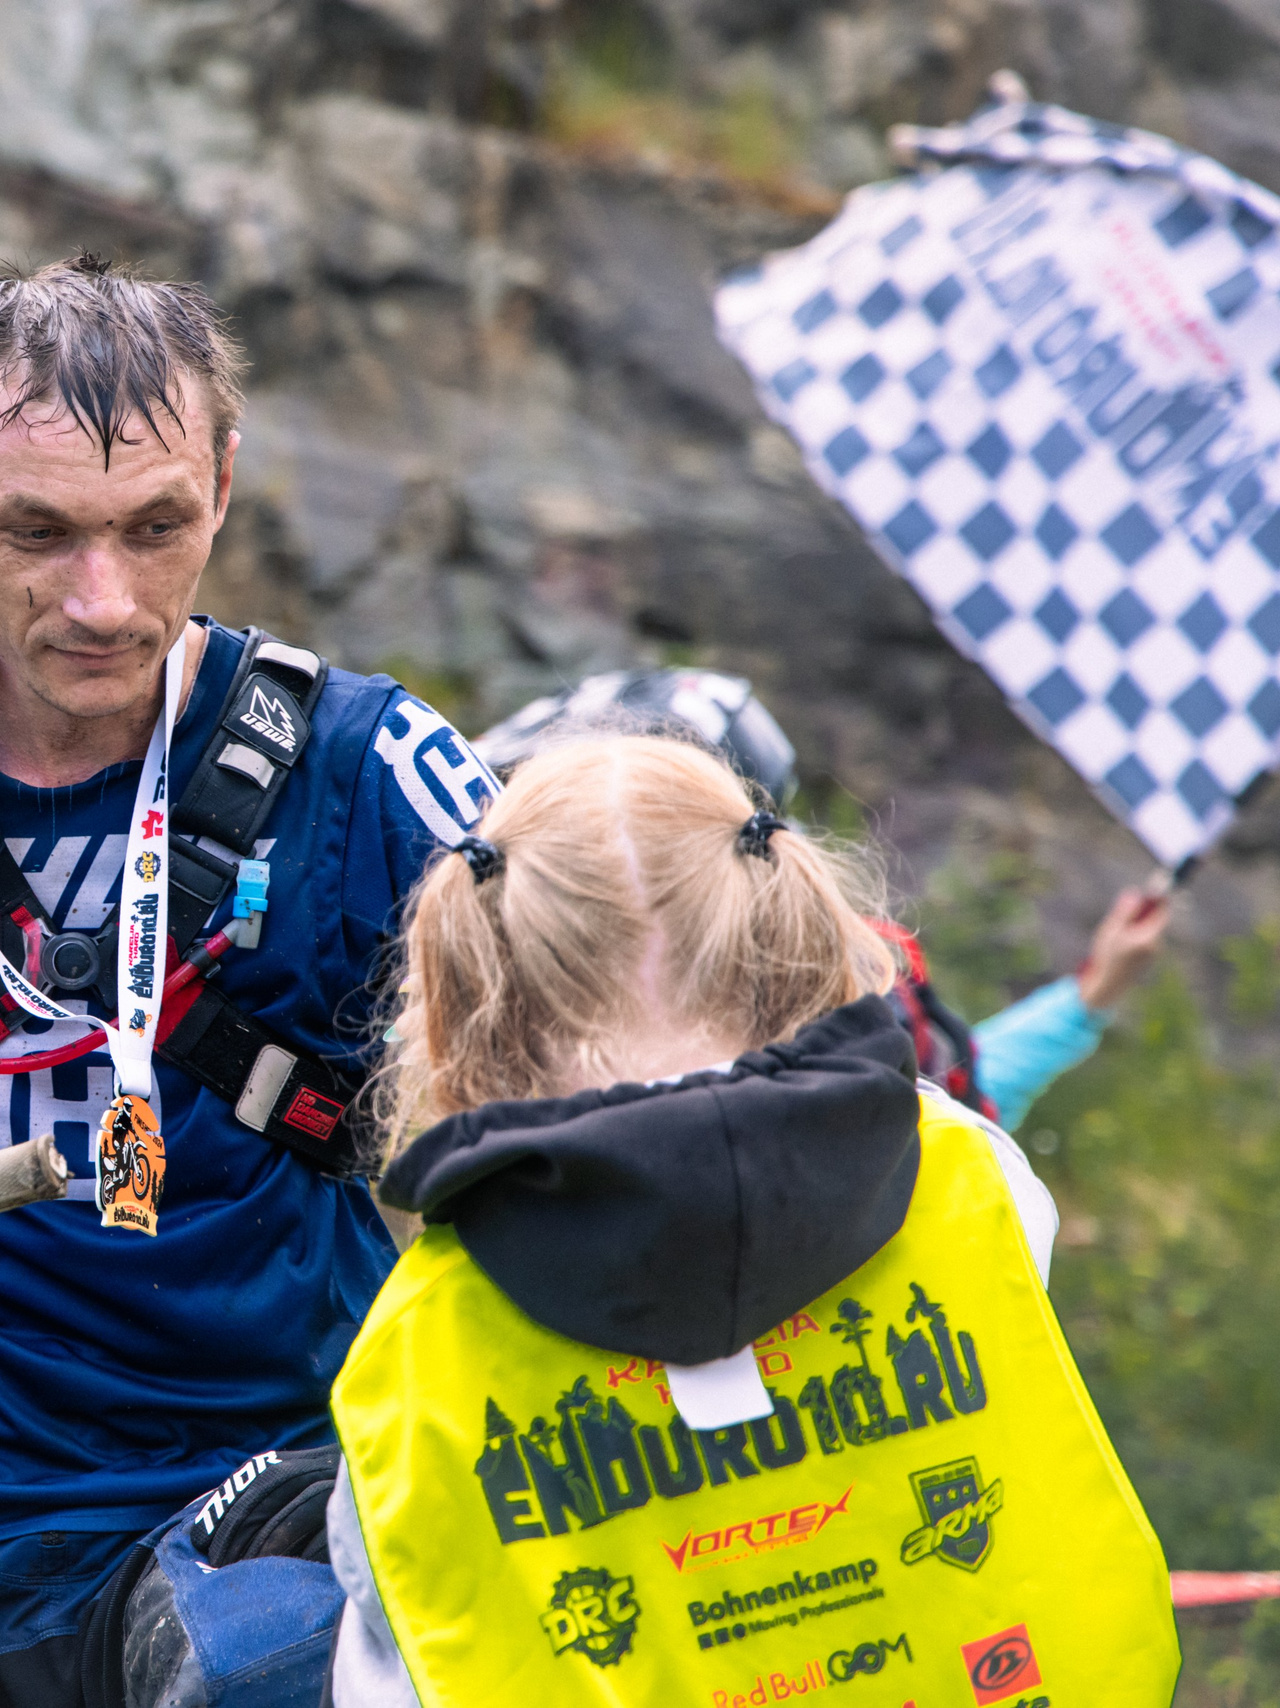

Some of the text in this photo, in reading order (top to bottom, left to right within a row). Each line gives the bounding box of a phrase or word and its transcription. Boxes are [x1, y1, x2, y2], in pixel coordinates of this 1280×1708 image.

[142, 851, 156, 883] DRC
[127, 893, 159, 999] ENDURO10.RU
[300, 1092, 317, 1107] NO
[194, 1450, 283, 1535] THOR
[660, 1481, 856, 1574] VORTEX
[538, 1574, 642, 1657] DRC
[687, 1558, 879, 1628] Bohnenkamp
